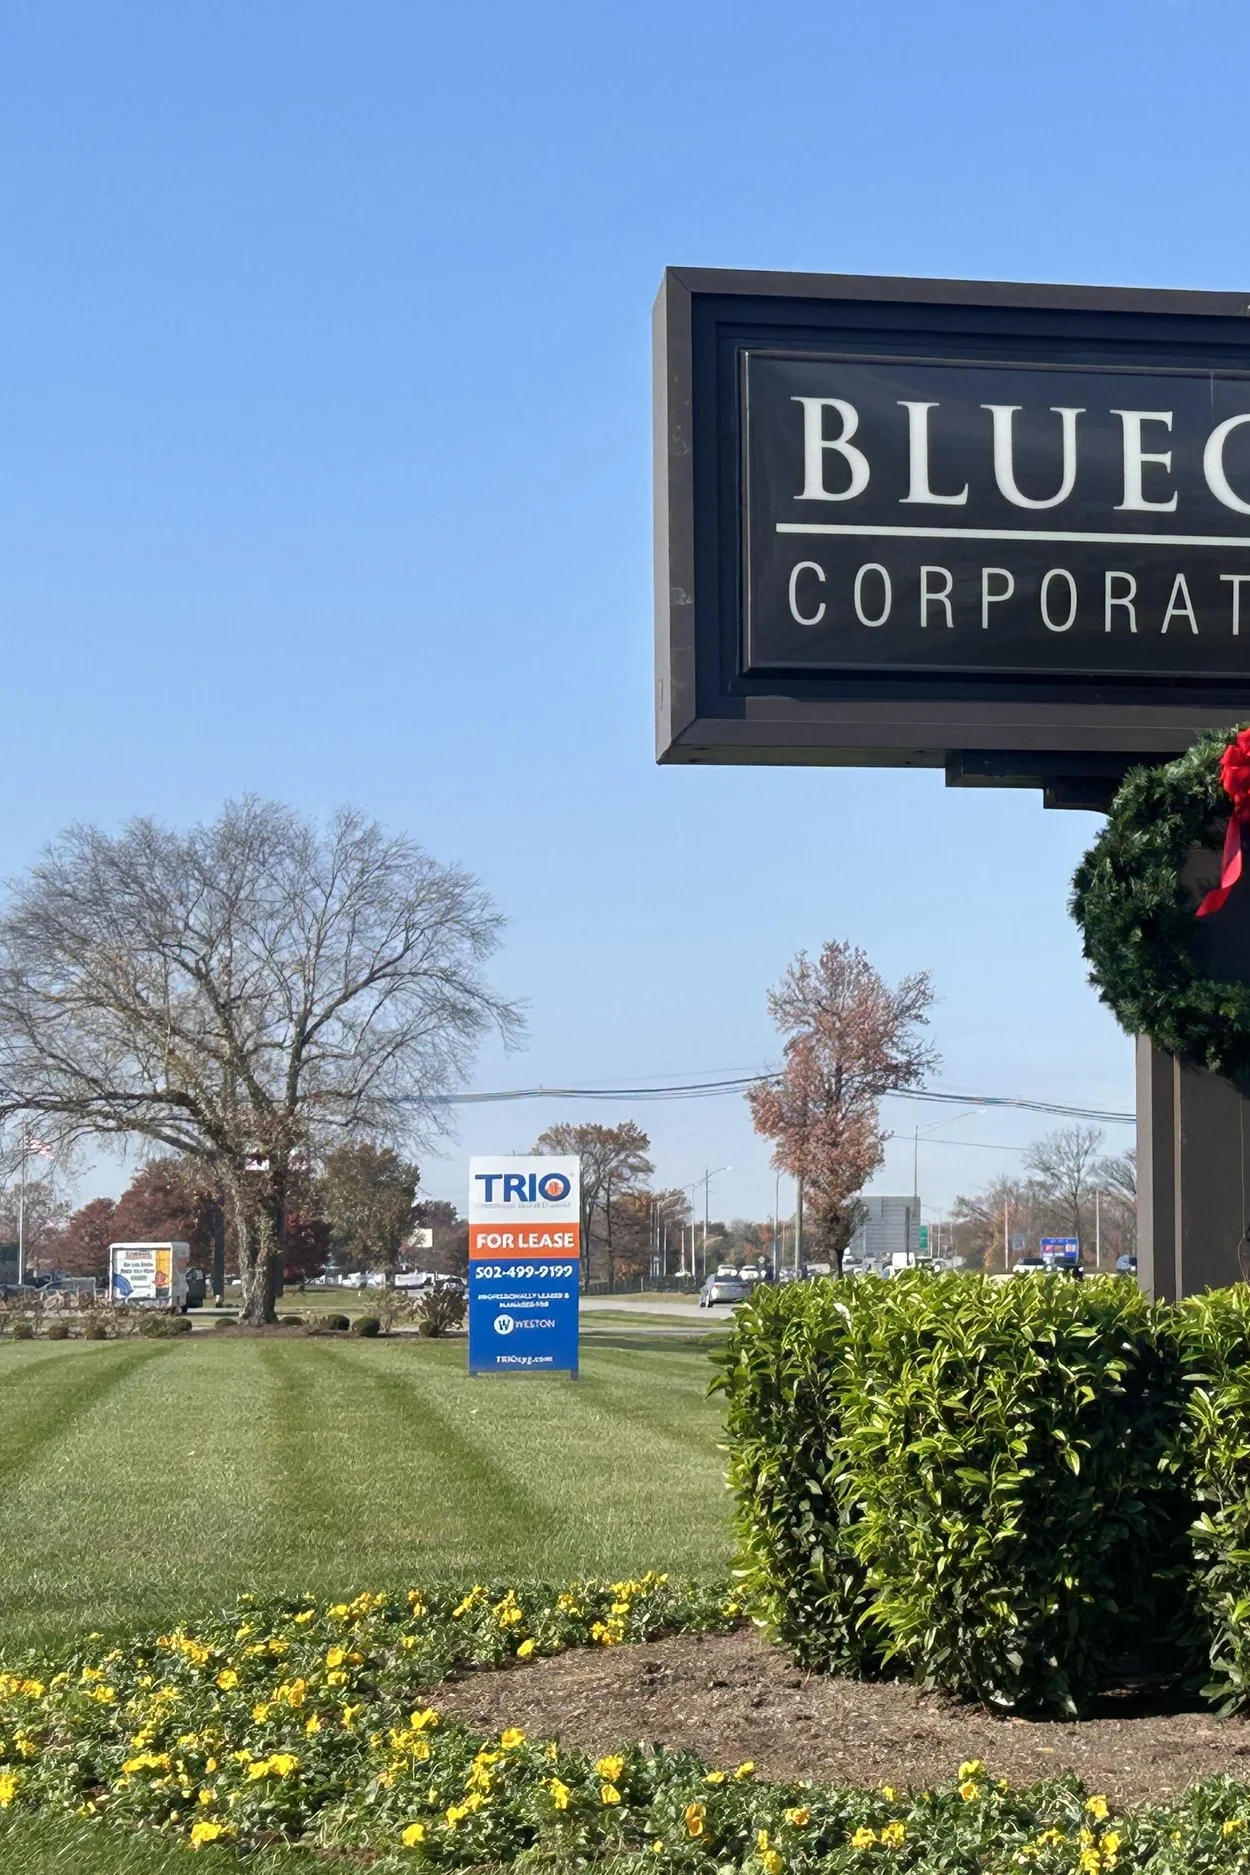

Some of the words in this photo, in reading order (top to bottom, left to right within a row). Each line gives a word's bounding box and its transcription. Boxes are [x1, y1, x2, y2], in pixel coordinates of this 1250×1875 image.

[475, 1173, 571, 1202] TRIO
[476, 1233, 514, 1248] FOR
[518, 1232, 575, 1248] LEASE
[475, 1265, 573, 1279] 502-499-9199
